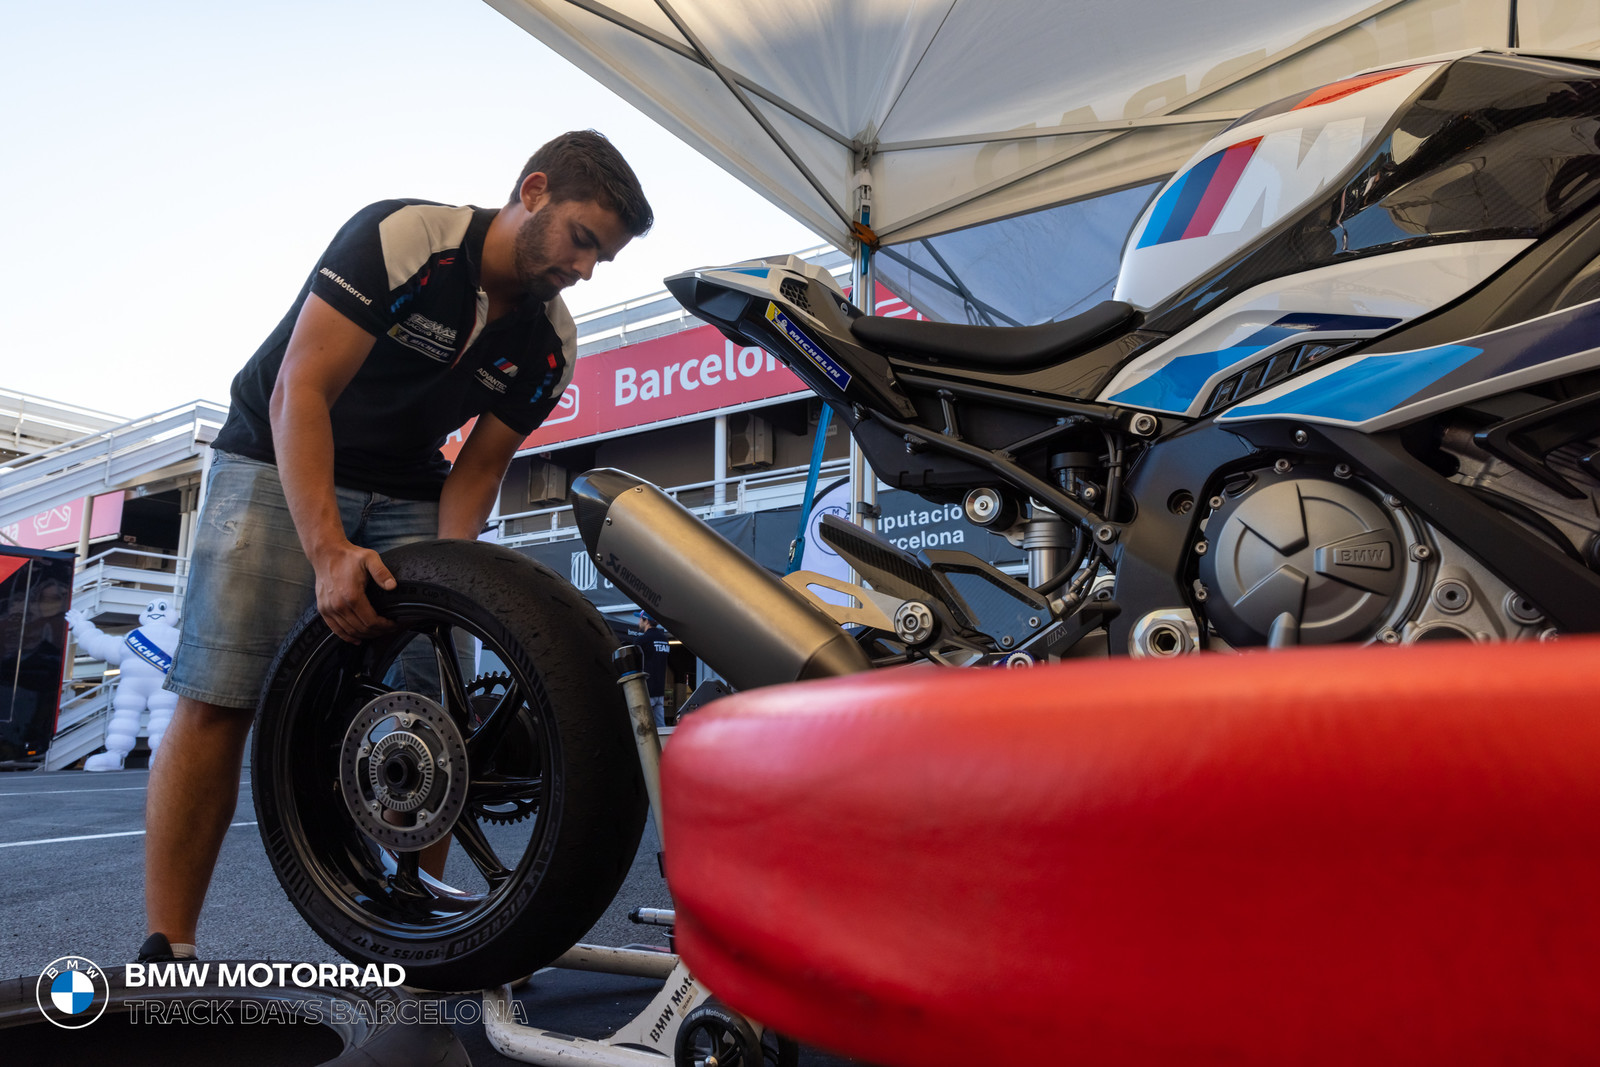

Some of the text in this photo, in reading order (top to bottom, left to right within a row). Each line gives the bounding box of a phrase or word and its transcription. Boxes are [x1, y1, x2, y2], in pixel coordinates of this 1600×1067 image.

[334, 276, 373, 306] Motorrad
[789, 330, 841, 379] MICHELIN
[477, 367, 507, 391] ADVANTEC
[877, 503, 964, 534] iputació
[889, 529, 964, 551] rcelona
[1341, 548, 1385, 562] BMW
[128, 636, 171, 669] MICHELI
[454, 888, 528, 955] MICHELIN
[352, 936, 440, 960] 190/55 ZR 17
[650, 1004, 674, 1043] BMW
[705, 1008, 732, 1023] Motorrad
